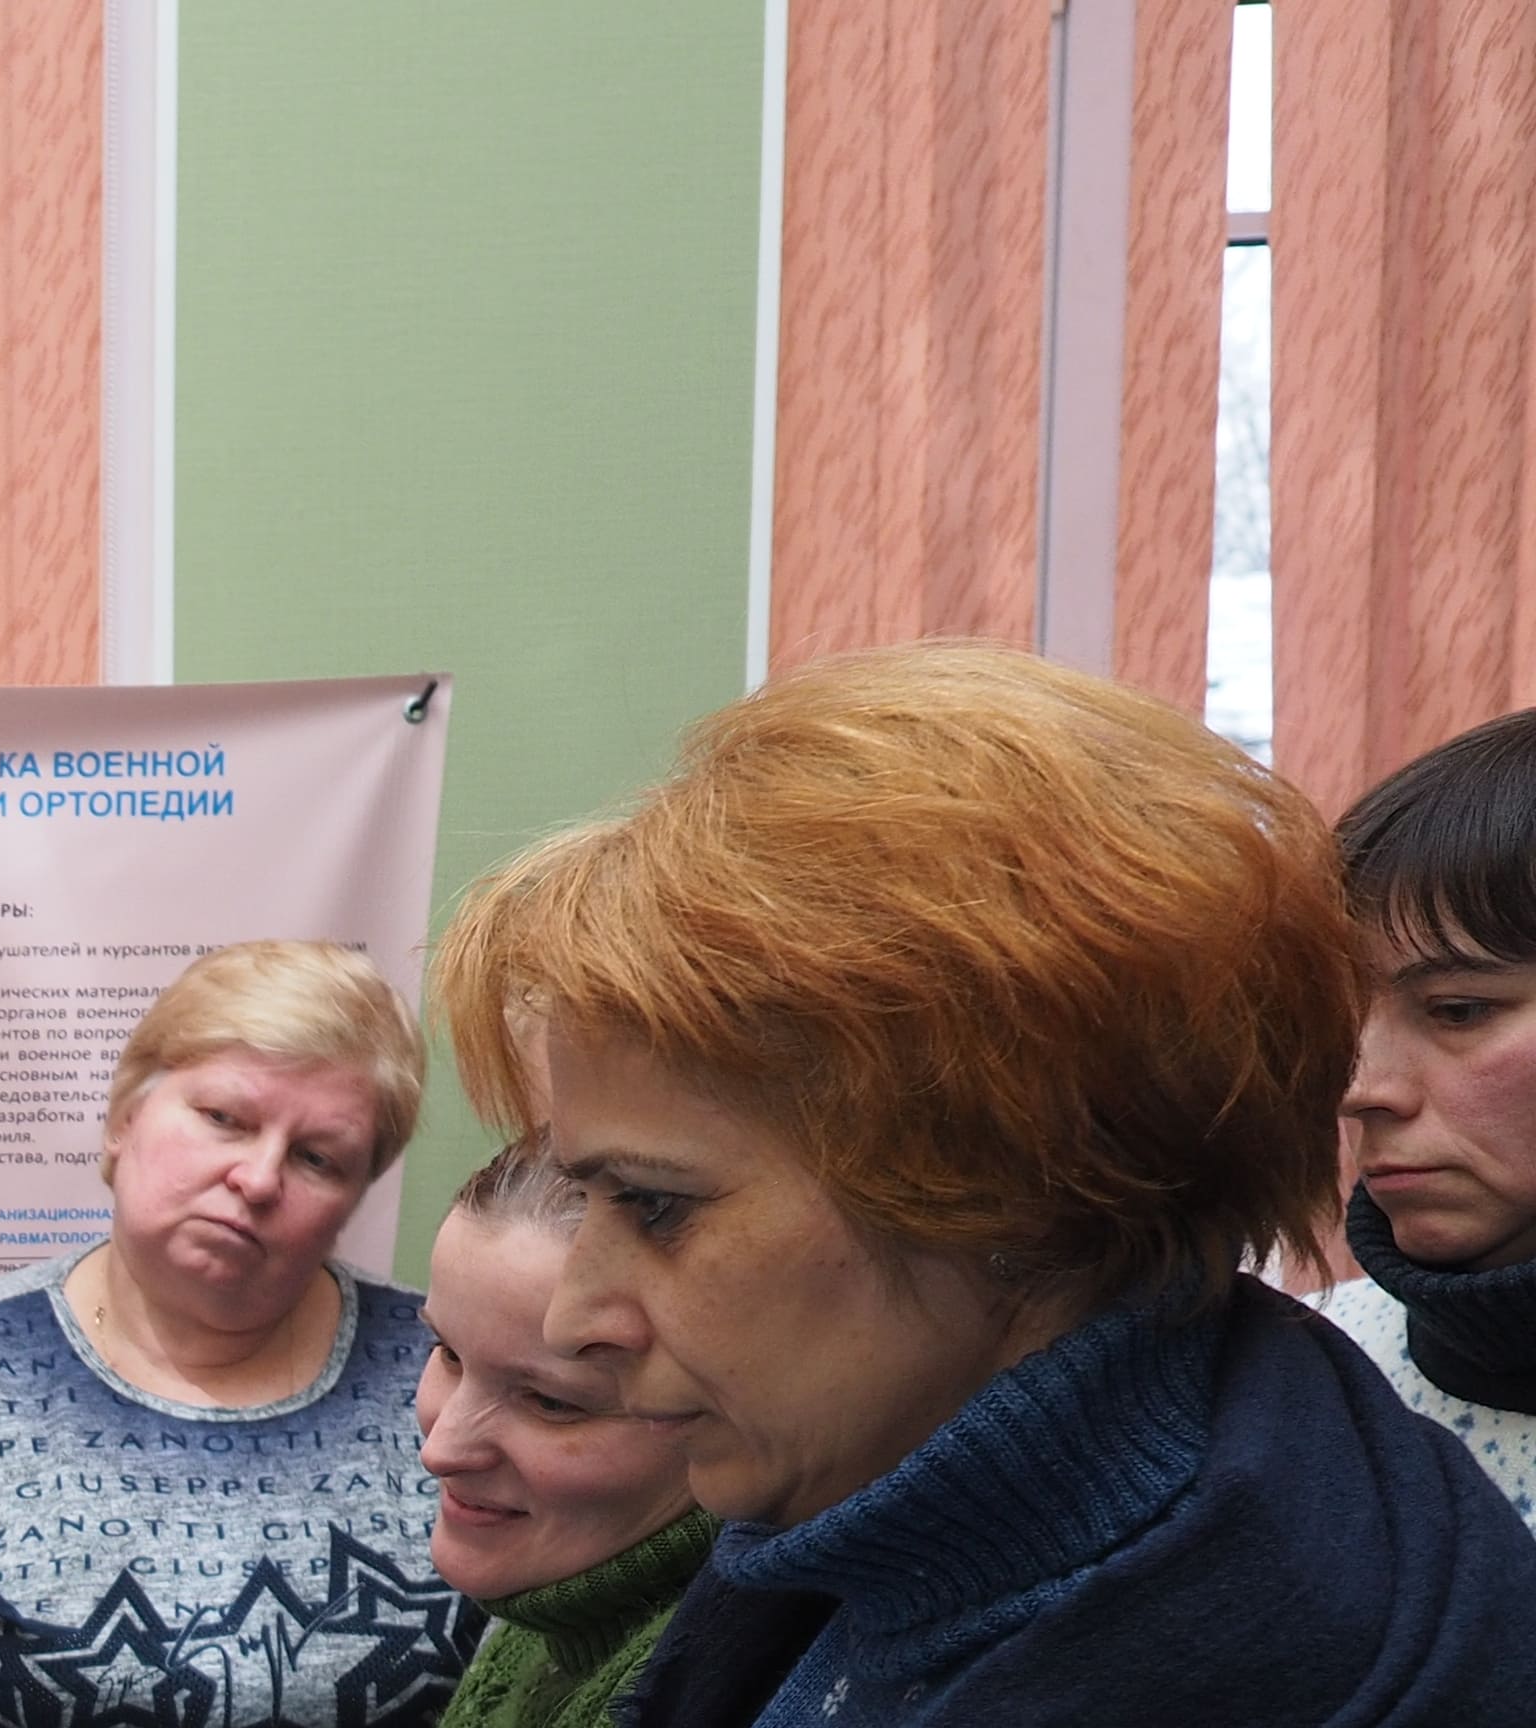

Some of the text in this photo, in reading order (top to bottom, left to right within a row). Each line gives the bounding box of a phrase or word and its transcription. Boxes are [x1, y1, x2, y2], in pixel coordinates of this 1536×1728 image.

[52, 743, 226, 779] ВОЕННОЙ
[19, 789, 235, 822] ОРТОПЕДИИ
[86, 944, 97, 957] и
[102, 944, 192, 960] курсантов
[46, 1028, 69, 1041] по
[0, 1048, 10, 1061] и
[17, 1048, 93, 1061] военное
[83, 1429, 323, 1454] ZANOTTI
[15, 1472, 277, 1497] GIUSEPPE
